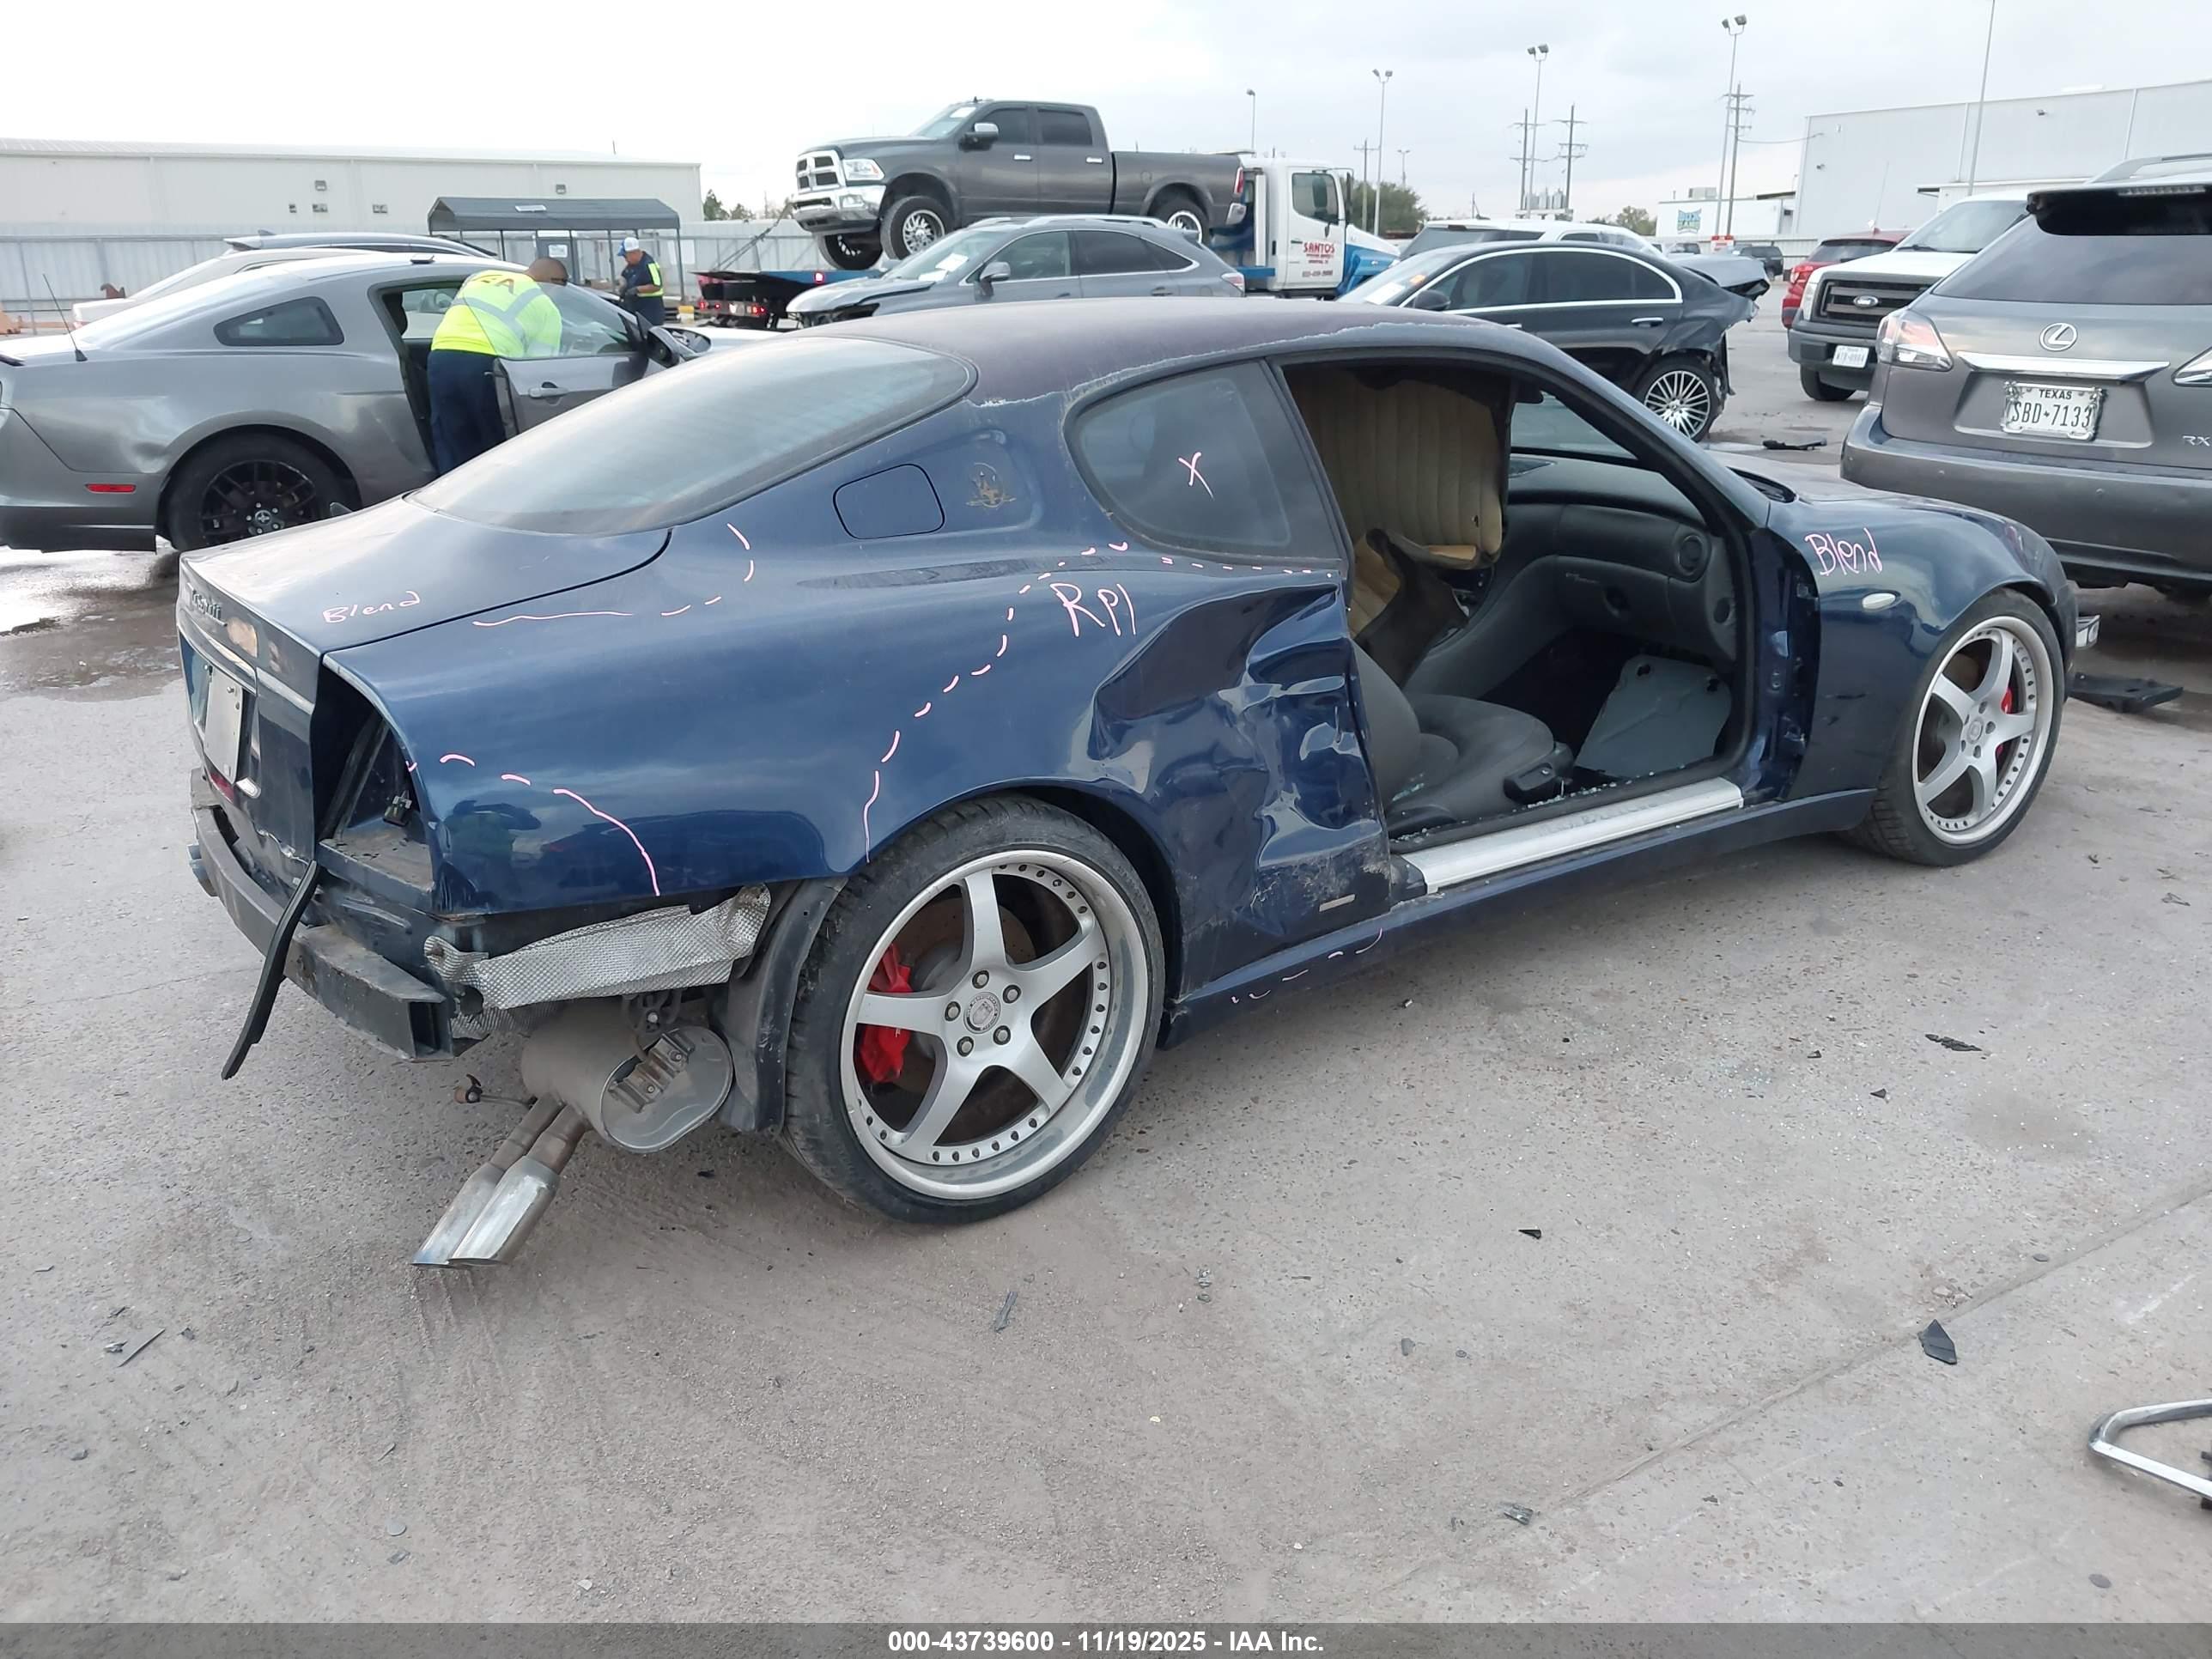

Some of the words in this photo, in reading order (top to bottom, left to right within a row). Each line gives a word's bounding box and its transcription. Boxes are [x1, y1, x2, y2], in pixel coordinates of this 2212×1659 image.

[1304, 242, 1334, 253] SANTOS
[2039, 389, 2073, 400] TEXAS
[2182, 434, 2211, 447] RX
[1804, 526, 1883, 576] Blend
[322, 590, 421, 624] Blend
